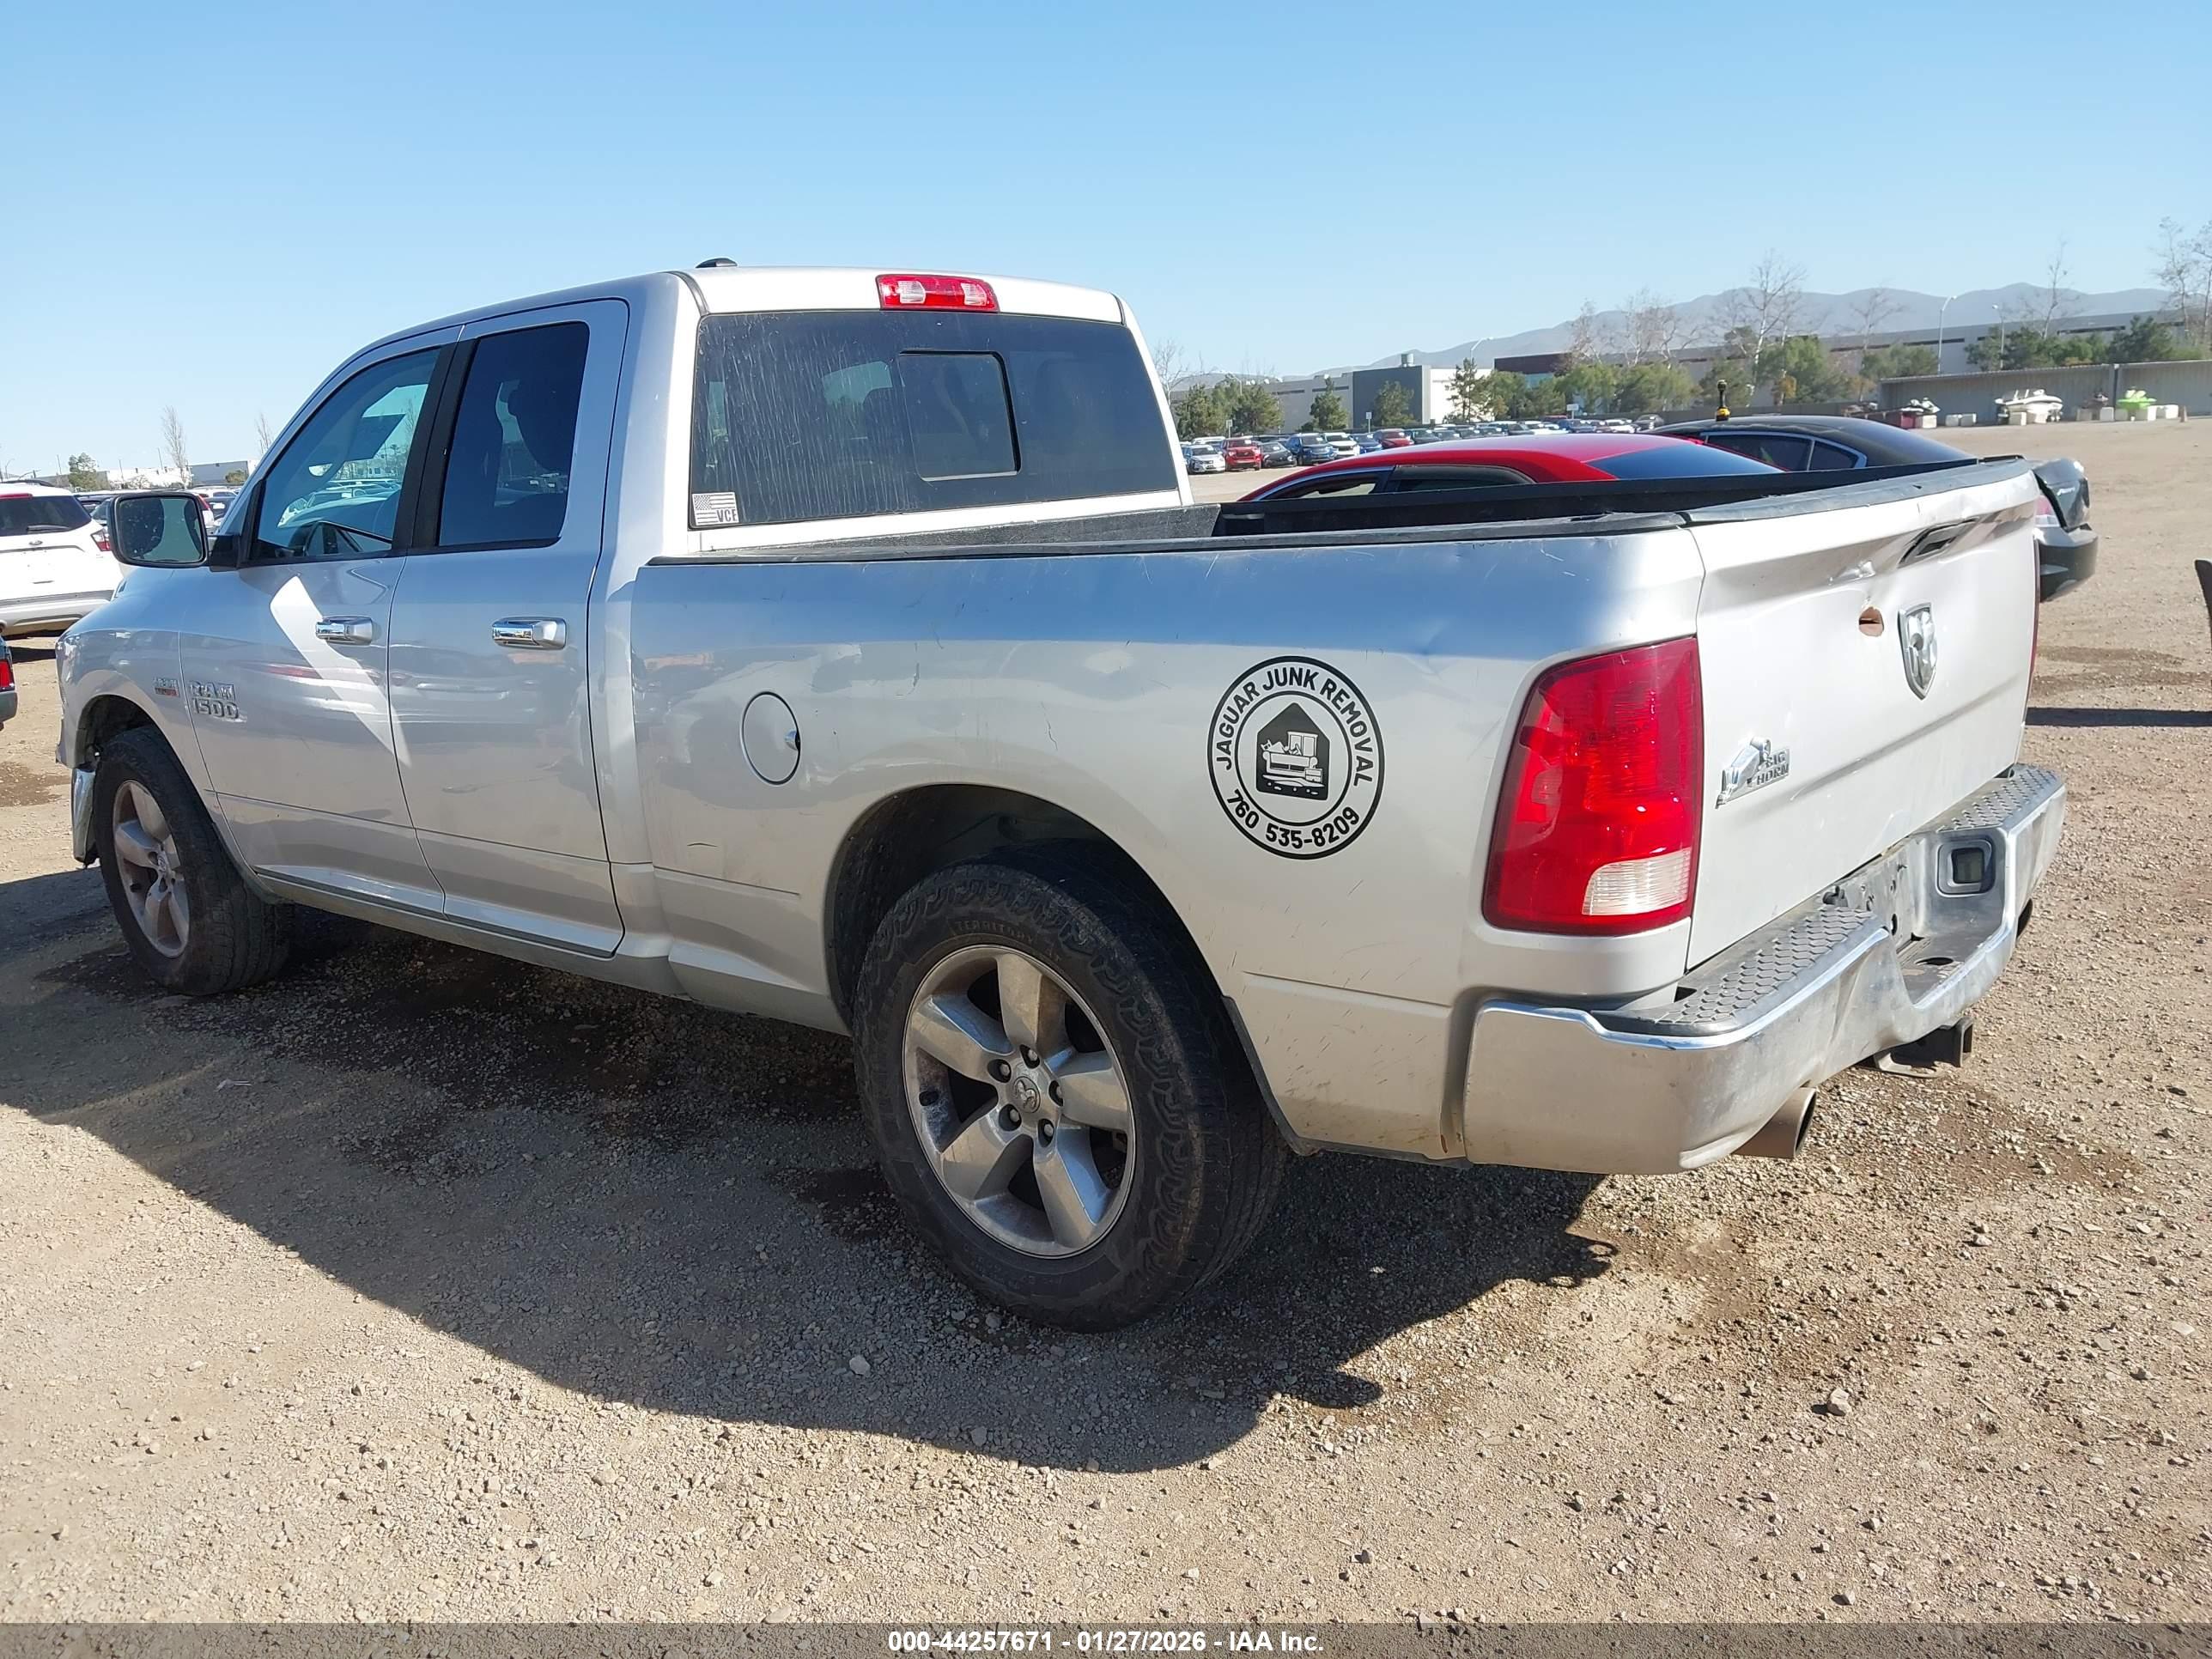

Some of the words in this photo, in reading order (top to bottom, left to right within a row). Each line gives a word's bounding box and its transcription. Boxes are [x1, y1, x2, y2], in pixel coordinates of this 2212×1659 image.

[189, 681, 236, 699] RAM
[193, 697, 239, 719] 1500
[1216, 682, 1261, 770] JAGUAR
[1262, 667, 1319, 690] JUNK
[1321, 678, 1373, 787] REMOVAL
[1765, 751, 1786, 769] BIG
[1757, 763, 1790, 785] HORN
[1227, 788, 1260, 830] 760
[1265, 806, 1360, 849] 535-8209
